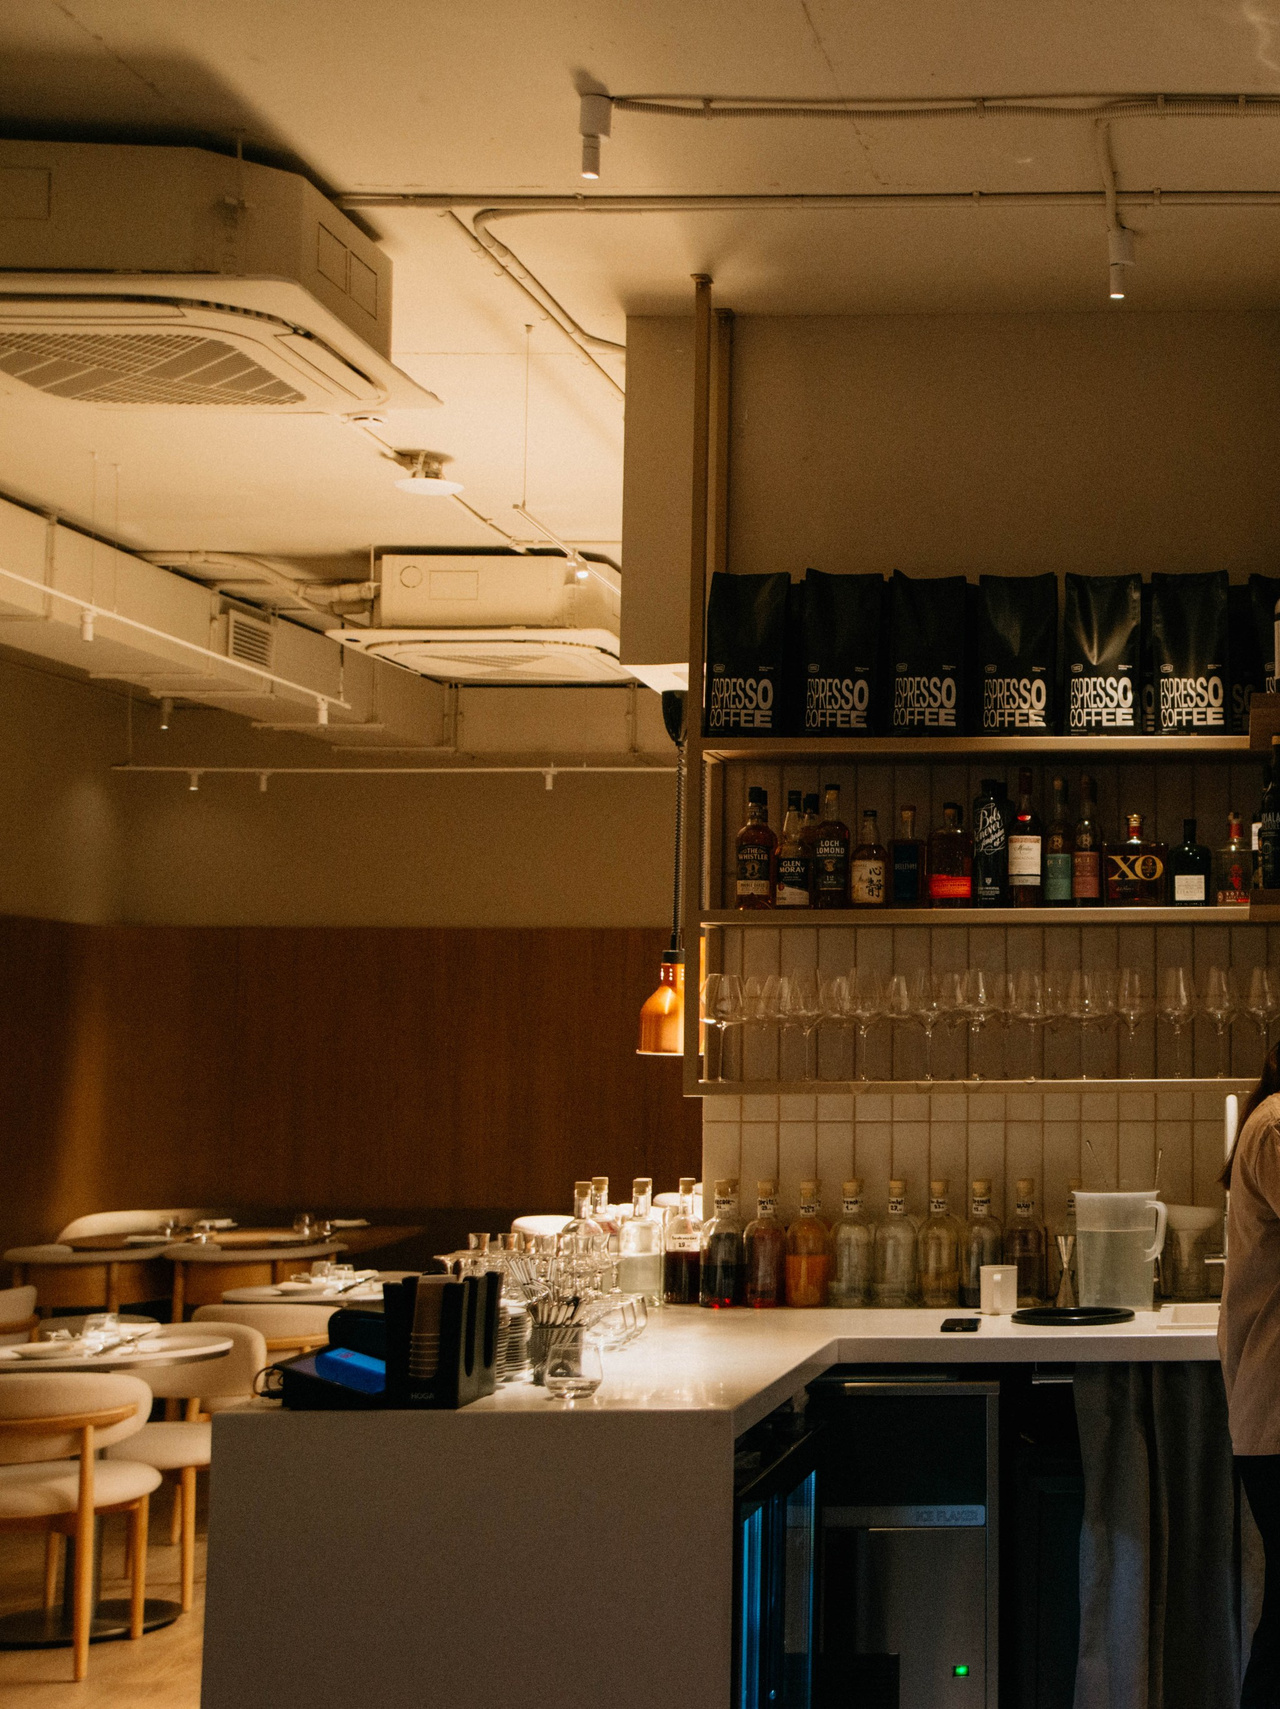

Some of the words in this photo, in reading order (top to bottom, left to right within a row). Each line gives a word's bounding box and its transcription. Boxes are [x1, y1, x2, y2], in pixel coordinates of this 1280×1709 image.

[711, 678, 773, 710] ESPRESSO
[807, 678, 869, 710] ESPRESSO
[894, 676, 956, 709] ESPRESSO
[984, 678, 1047, 710] ESPRESSO
[1070, 676, 1133, 709] ESPRESSO
[1160, 676, 1224, 709] ESPRESSO
[710, 709, 773, 728] COFFEE
[805, 709, 867, 728] COFFEE
[893, 708, 956, 727] COFFEE
[983, 709, 1047, 728] COFFEE
[1069, 707, 1134, 727] COFFEE
[1160, 707, 1225, 727] COFFEE
[1108, 855, 1164, 881] XO
